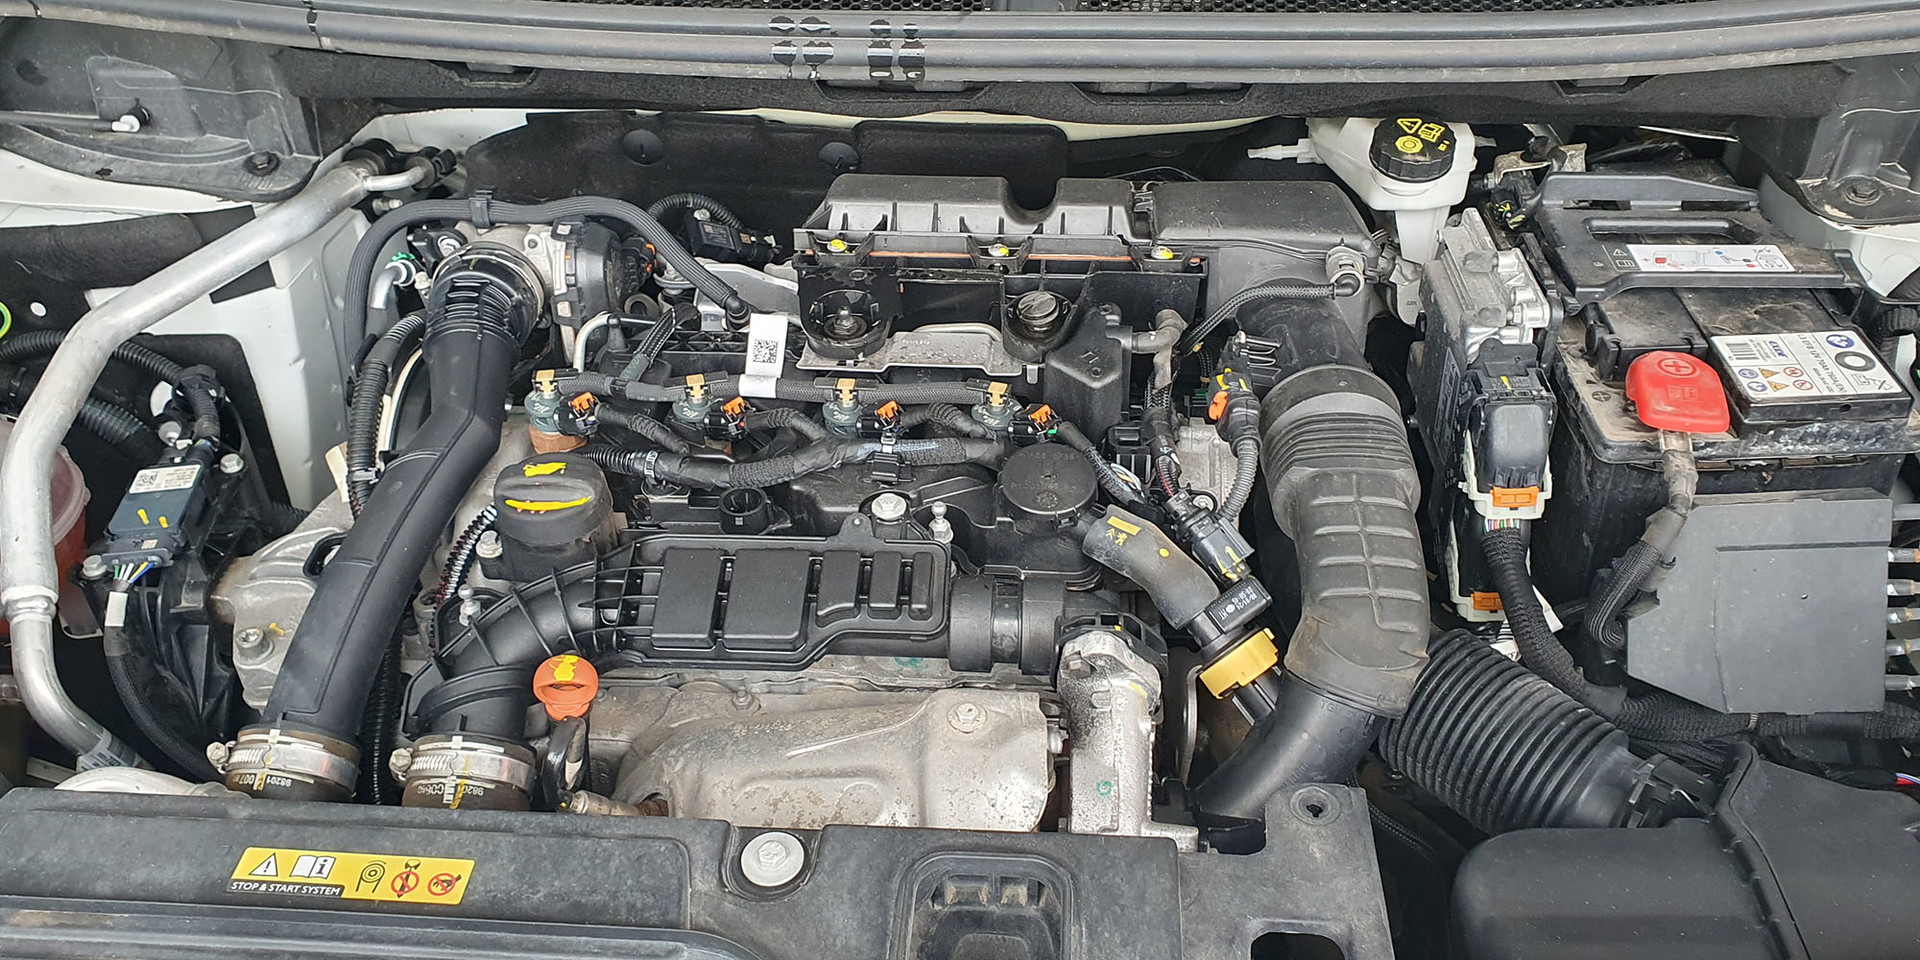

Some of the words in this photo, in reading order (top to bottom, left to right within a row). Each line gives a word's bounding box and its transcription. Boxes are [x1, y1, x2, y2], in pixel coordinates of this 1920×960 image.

[231, 881, 259, 891] STOP
[259, 883, 267, 892] &
[268, 883, 302, 894] START
[301, 885, 341, 896] SYSTEM
